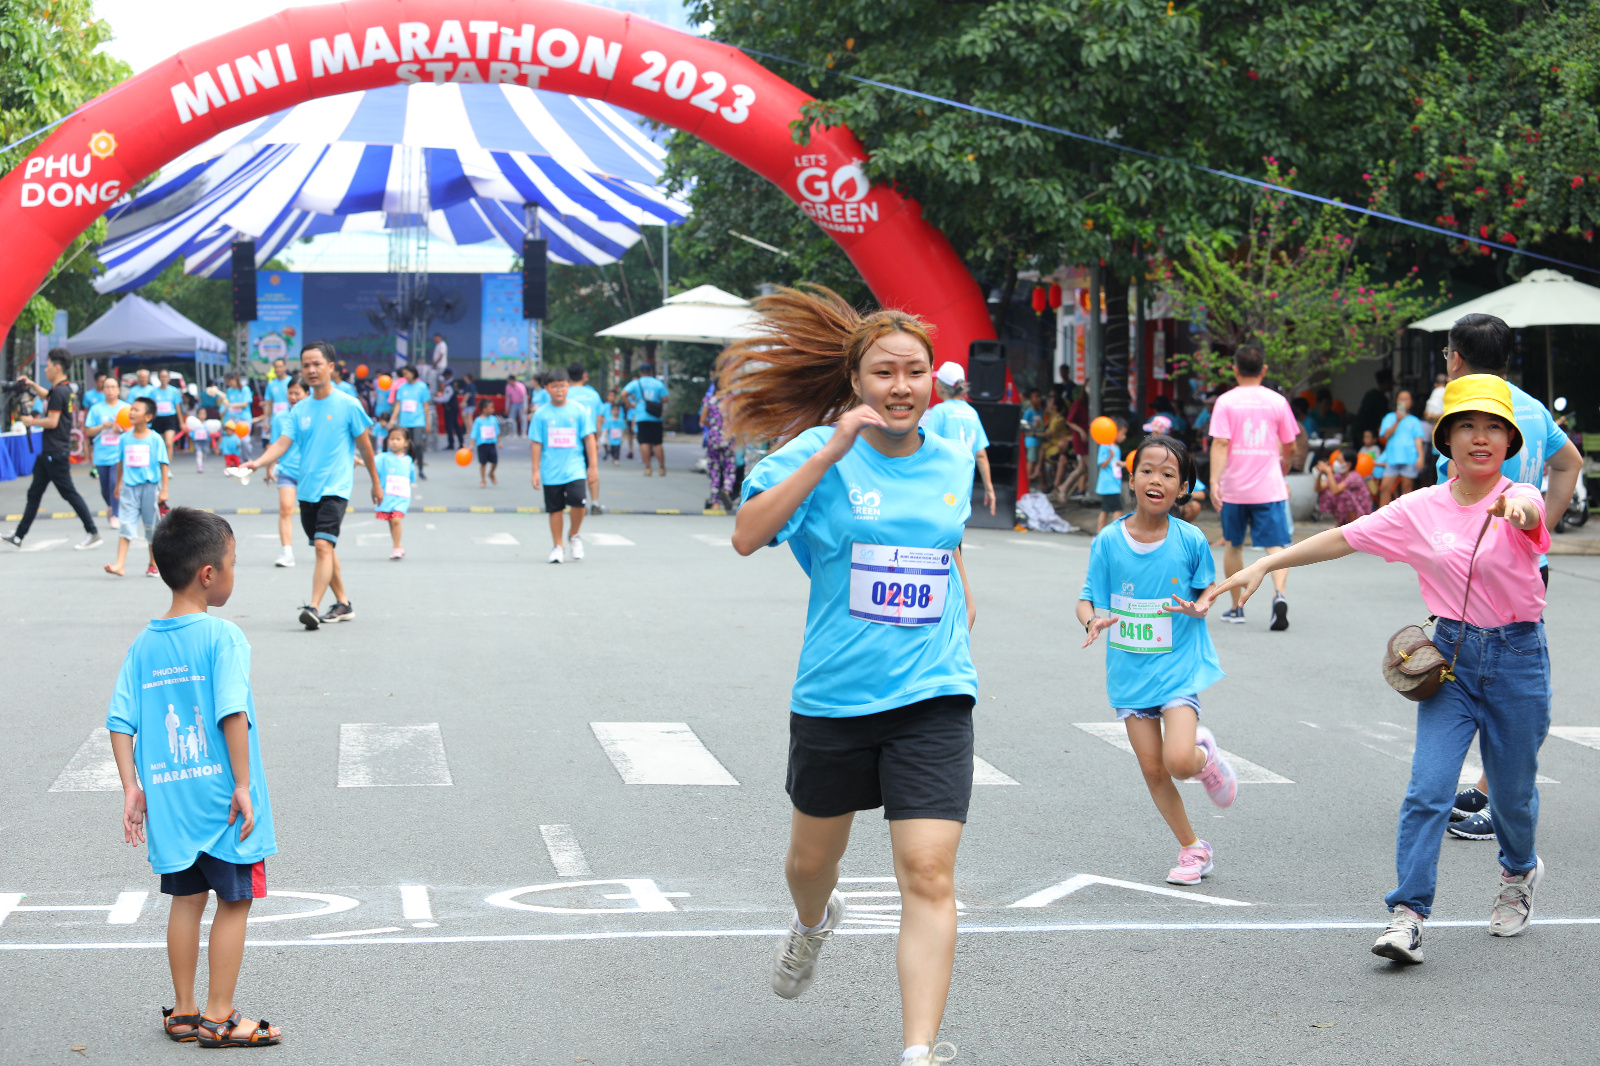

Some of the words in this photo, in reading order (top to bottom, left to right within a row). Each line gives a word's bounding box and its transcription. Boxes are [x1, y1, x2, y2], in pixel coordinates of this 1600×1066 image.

[170, 43, 297, 124] MINI
[310, 20, 622, 80] MARATHON
[632, 50, 756, 124] 2023
[396, 61, 549, 88] START
[24, 153, 91, 179] PHU
[794, 154, 828, 167] LET'S
[21, 180, 121, 207] DONG
[796, 166, 869, 202] GO
[801, 201, 878, 222] GREEN
[849, 488, 880, 508] GO
[851, 505, 881, 516] GREEN
[872, 581, 931, 608] 0298
[1120, 621, 1153, 640] 0416
[153, 665, 188, 677] PHUDONG
[151, 762, 166, 770] MINI
[153, 764, 222, 784] MARATHON
